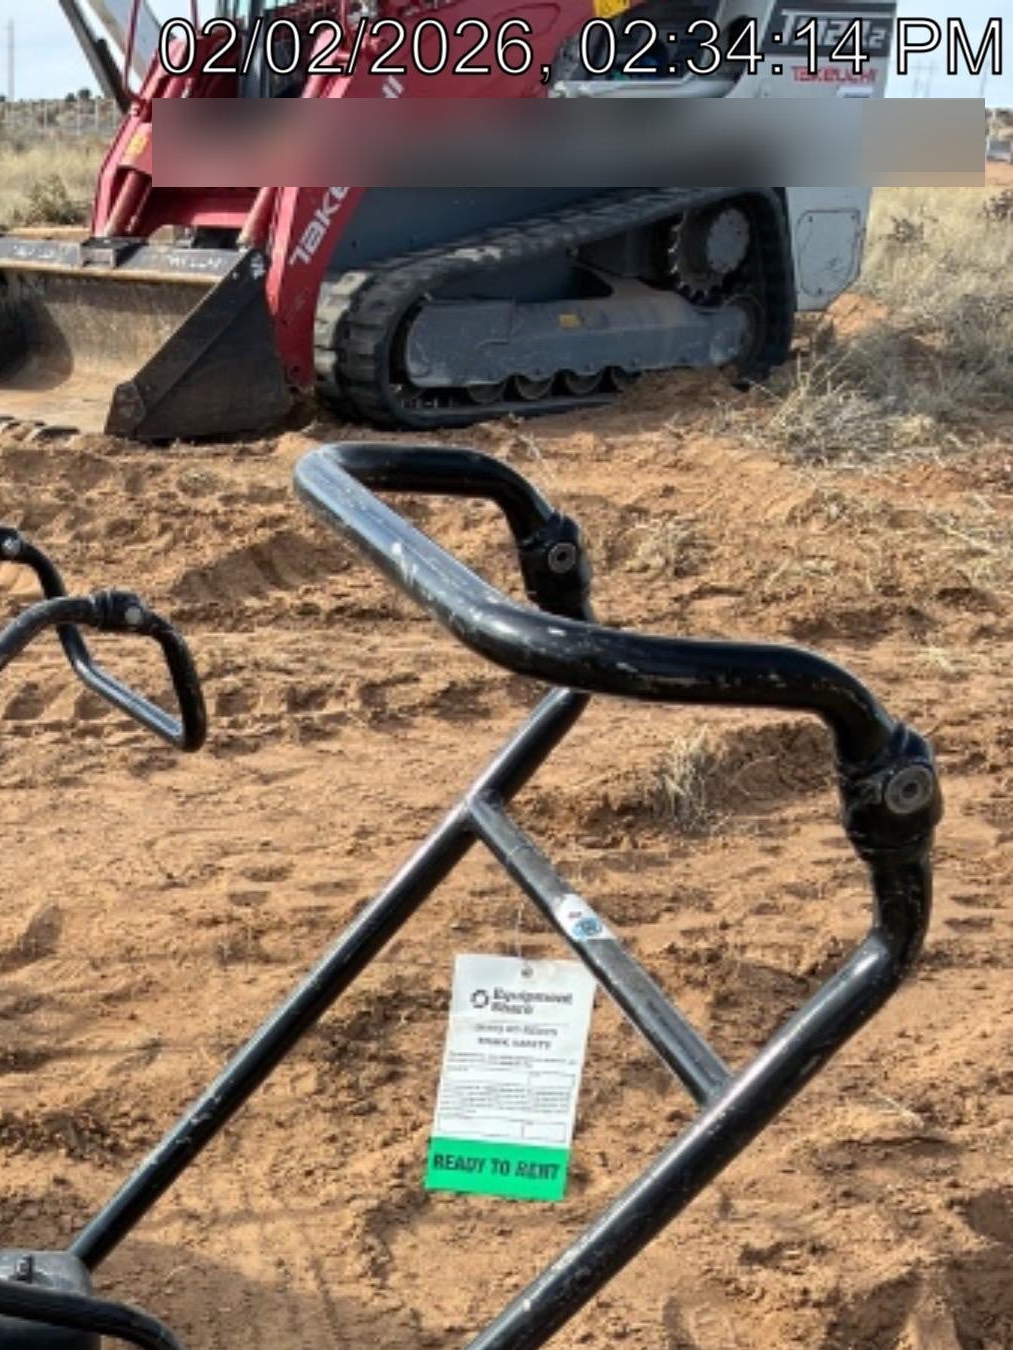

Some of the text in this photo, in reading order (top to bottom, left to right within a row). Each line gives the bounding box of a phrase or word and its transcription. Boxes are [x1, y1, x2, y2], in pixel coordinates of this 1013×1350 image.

[433, 1154, 561, 1181] READY TO RENT
